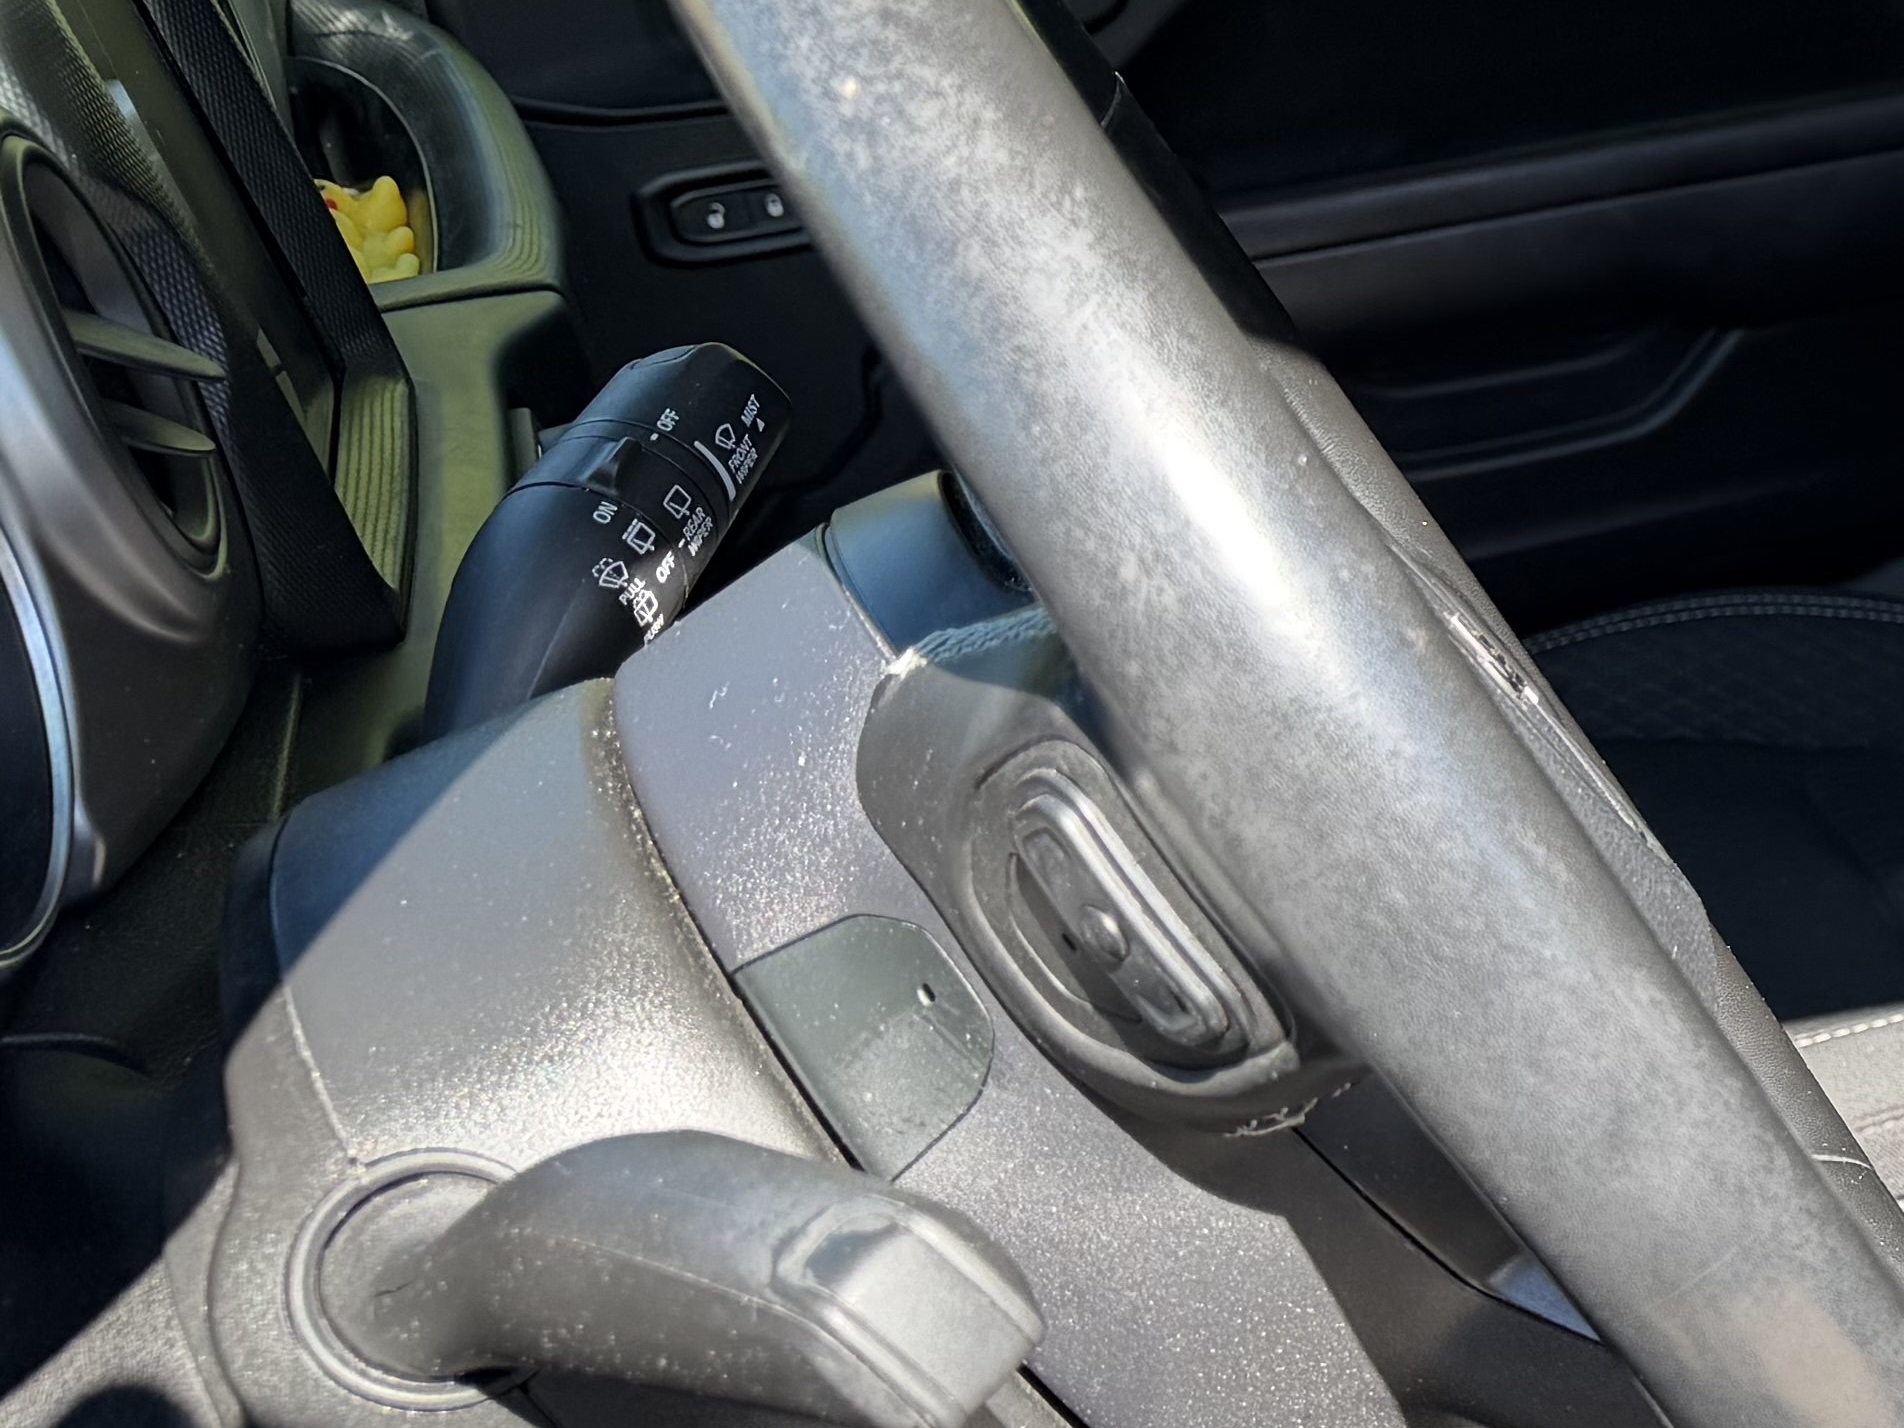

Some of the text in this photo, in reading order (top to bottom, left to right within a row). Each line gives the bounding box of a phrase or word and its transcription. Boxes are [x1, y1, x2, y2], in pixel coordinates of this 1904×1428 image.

[656, 408, 680, 431] OFF
[741, 393, 760, 427] MIST
[728, 434, 753, 473] FRONT
[735, 447, 758, 484] WIPER
[593, 501, 618, 524] ON
[683, 506, 706, 540] REAR
[688, 515, 713, 556] WIPER
[655, 550, 675, 584] OFF
[619, 578, 646, 605] PULL
